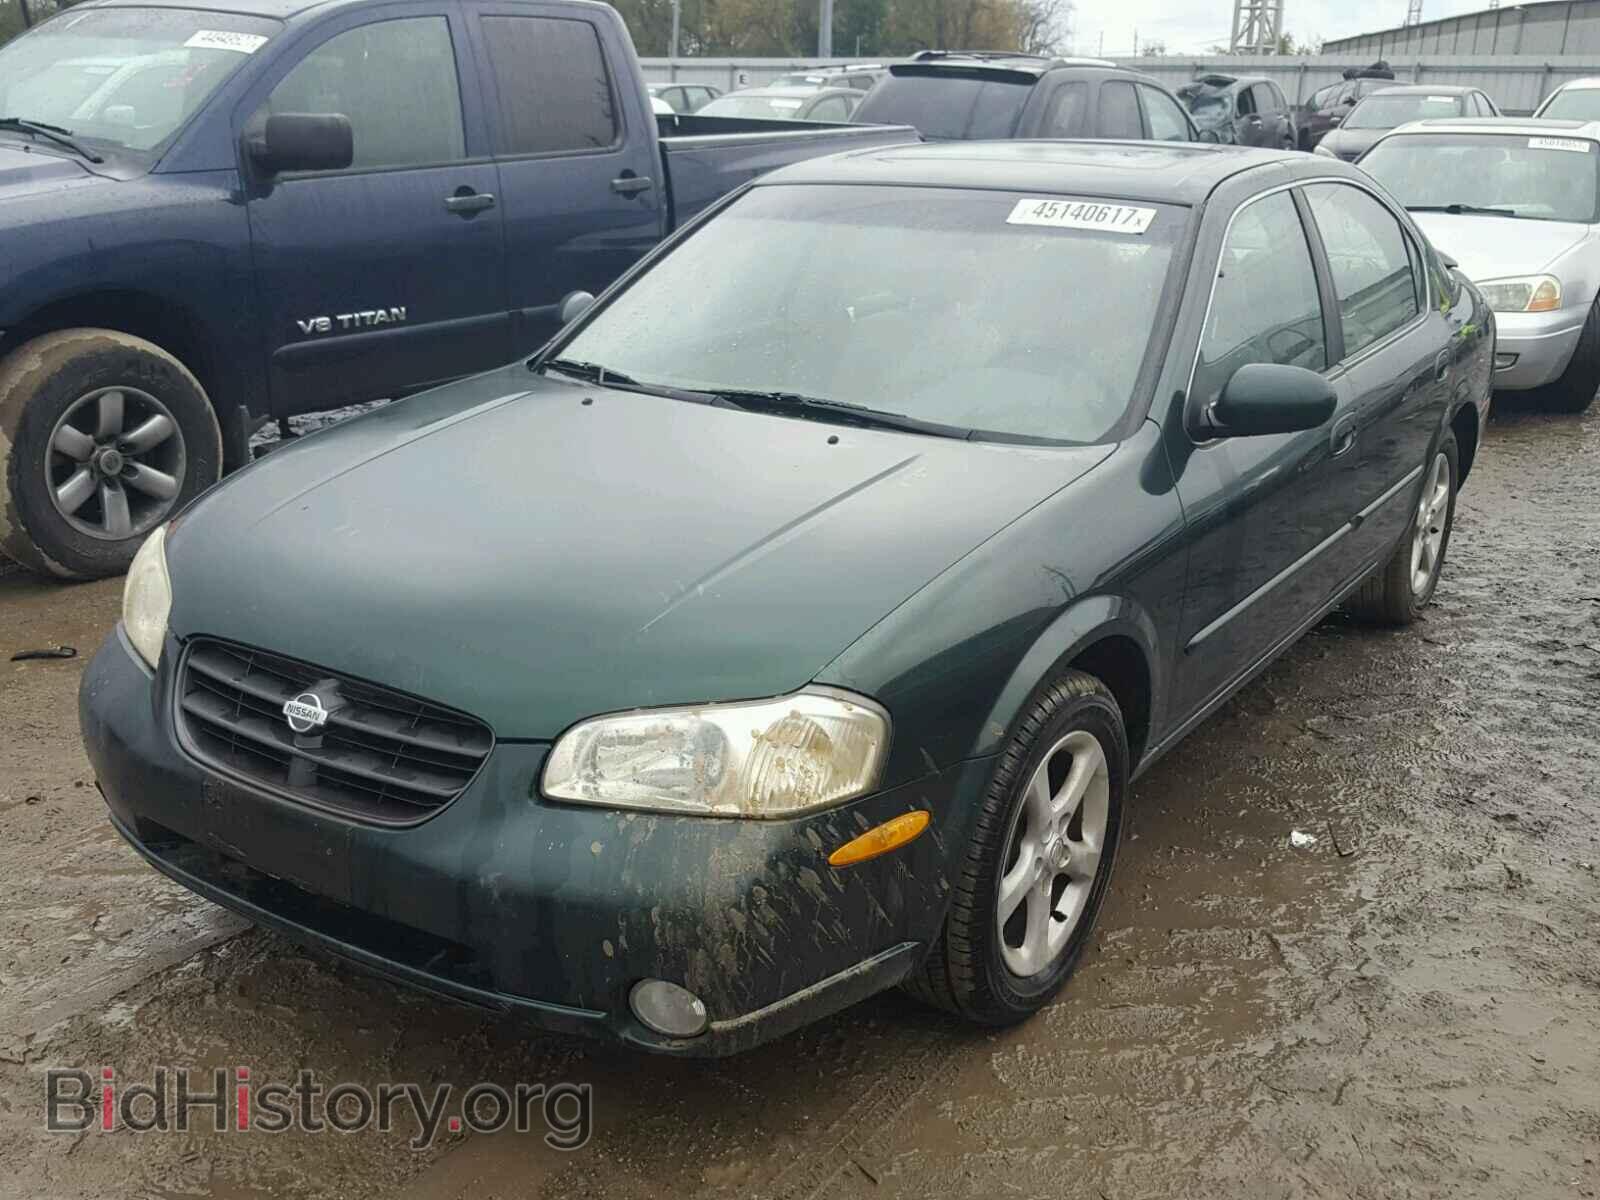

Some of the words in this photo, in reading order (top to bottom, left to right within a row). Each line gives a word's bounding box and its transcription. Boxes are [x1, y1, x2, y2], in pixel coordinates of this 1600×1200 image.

[1032, 201, 1138, 225] 45140617
[297, 317, 331, 335] V8
[336, 306, 406, 329] TITAN
[287, 703, 321, 721] NISSAN
